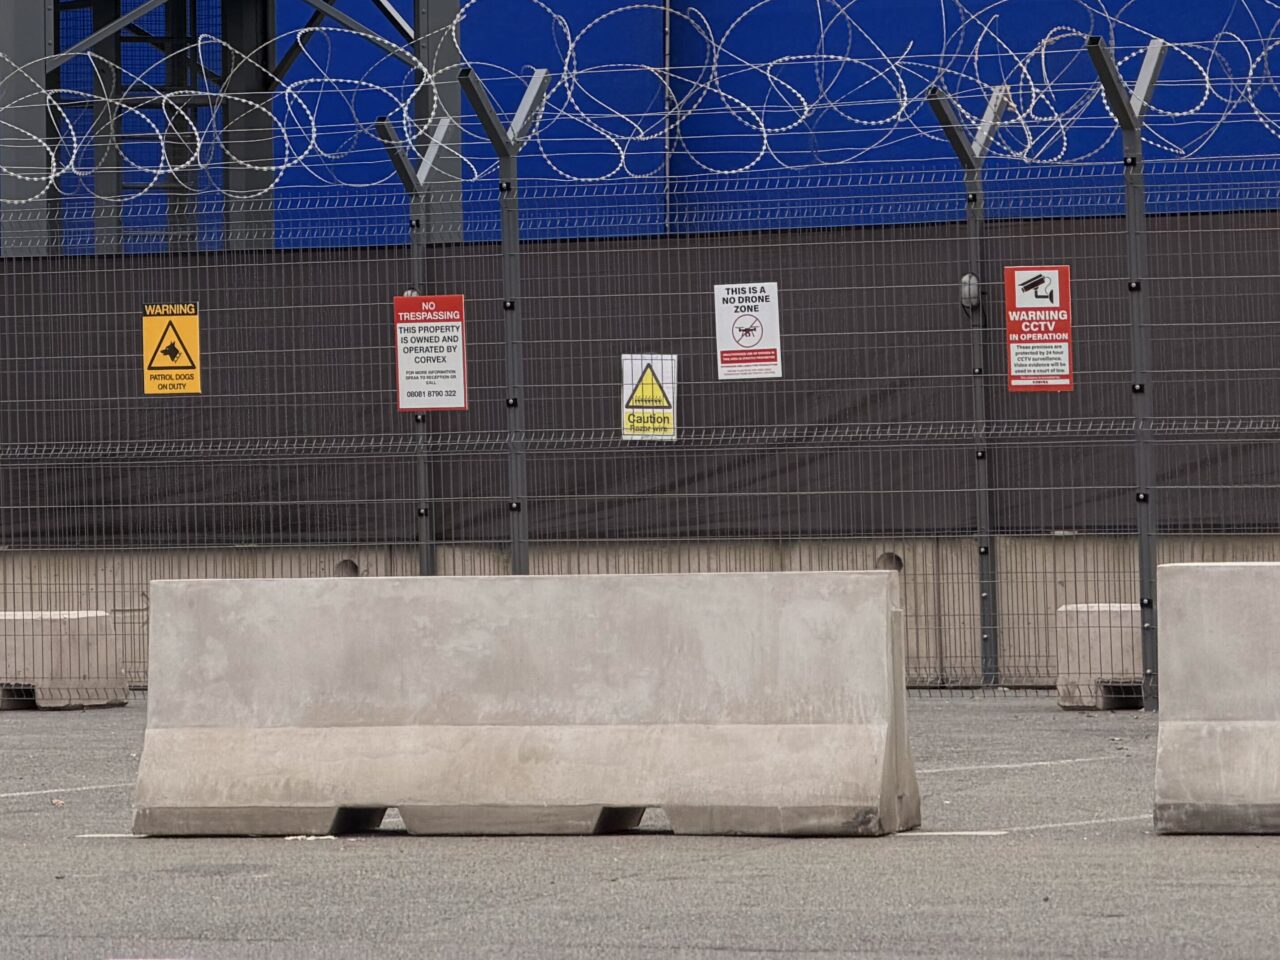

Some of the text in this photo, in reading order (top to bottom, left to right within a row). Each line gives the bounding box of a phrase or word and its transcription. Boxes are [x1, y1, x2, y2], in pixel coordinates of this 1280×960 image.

[725, 287, 747, 295] THIS
[760, 286, 766, 294] A
[722, 295, 770, 305] NO DRONE
[144, 304, 195, 315] WARNING
[421, 301, 435, 310] NO
[734, 305, 759, 313] ZONE
[398, 311, 460, 321] TRESPASSING
[1008, 310, 1068, 321] WARNING
[399, 325, 460, 334] THIS PROPERTY
[1021, 321, 1055, 332] CCTV
[410, 336, 440, 344] OWNED
[442, 335, 459, 343] AND
[1009, 333, 1068, 341] IN OPERATION
[403, 345, 458, 354] OPERATED BY
[414, 356, 447, 364] CORVEX
[628, 413, 670, 424] Caution
